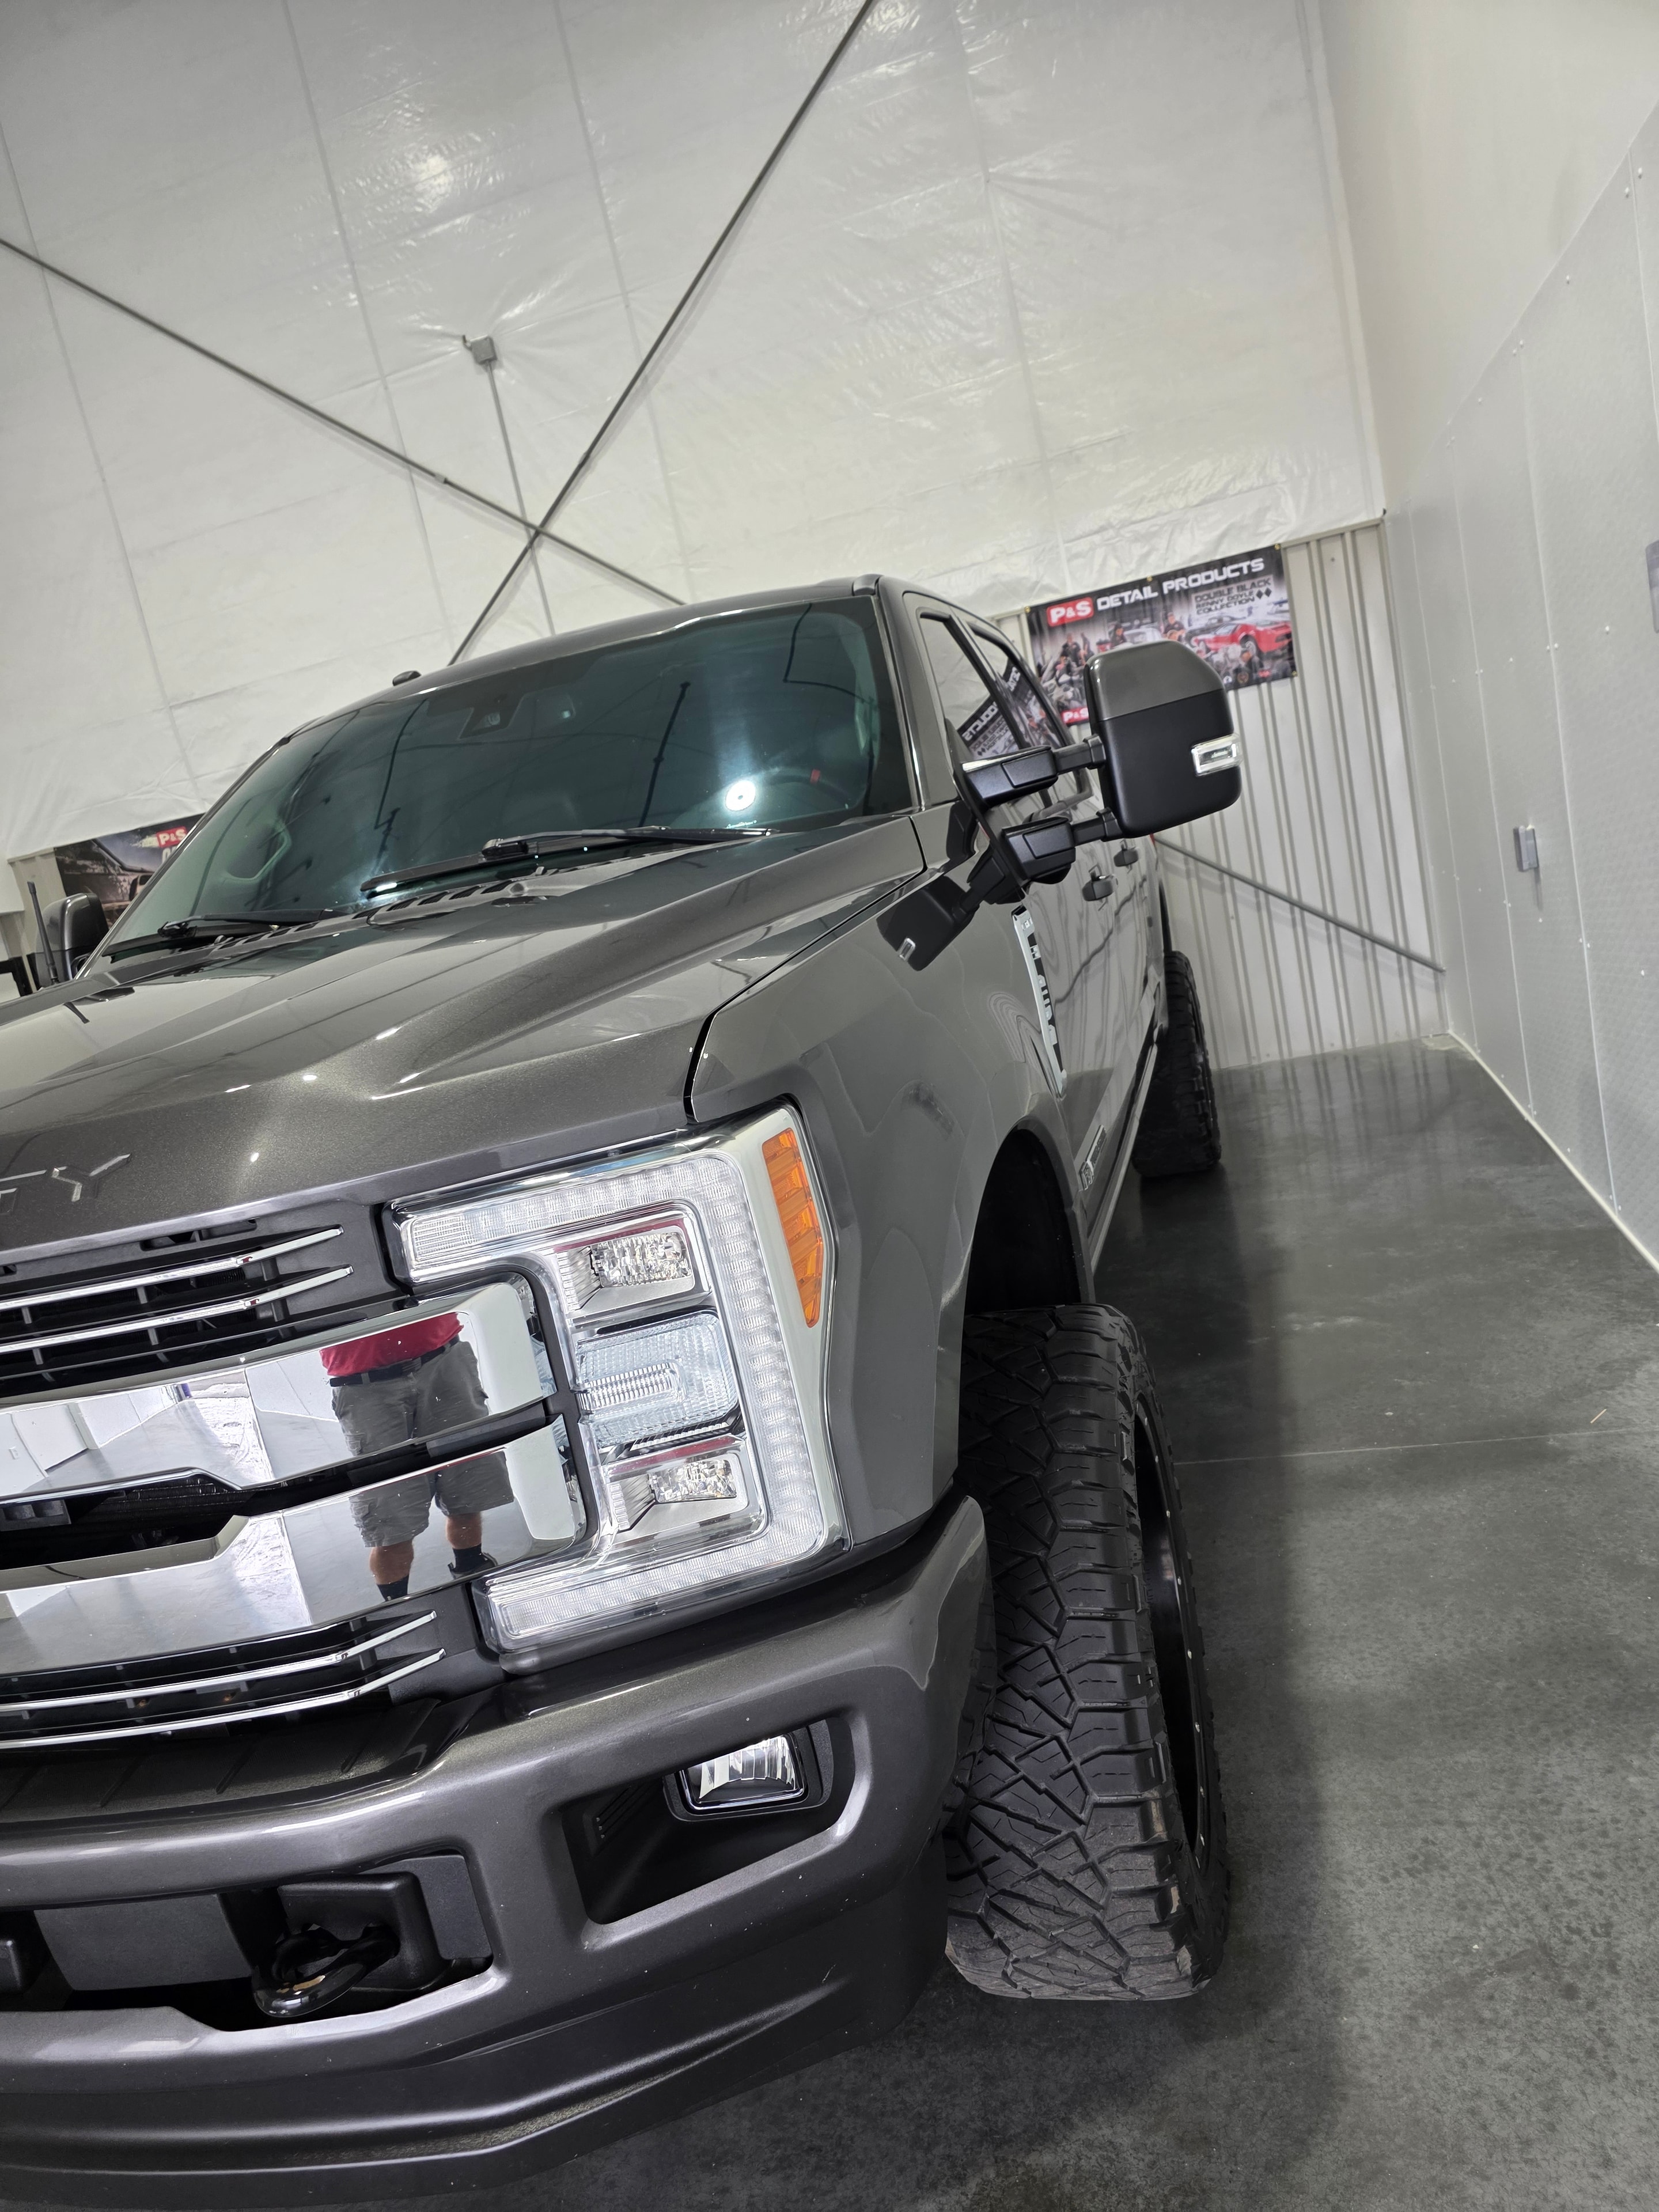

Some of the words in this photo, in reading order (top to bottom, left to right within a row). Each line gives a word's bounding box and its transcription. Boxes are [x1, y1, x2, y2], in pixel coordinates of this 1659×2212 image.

[1050, 600, 1092, 624] P&S
[1097, 585, 1159, 611] DETAIL
[1162, 558, 1264, 594] PRODUCTS
[1194, 587, 1233, 603] DOUBLE
[1236, 578, 1271, 592] BLACK
[1227, 590, 1254, 601] DOYLE
[1196, 596, 1255, 615] COLLECTION
[159, 828, 187, 845] P&S
